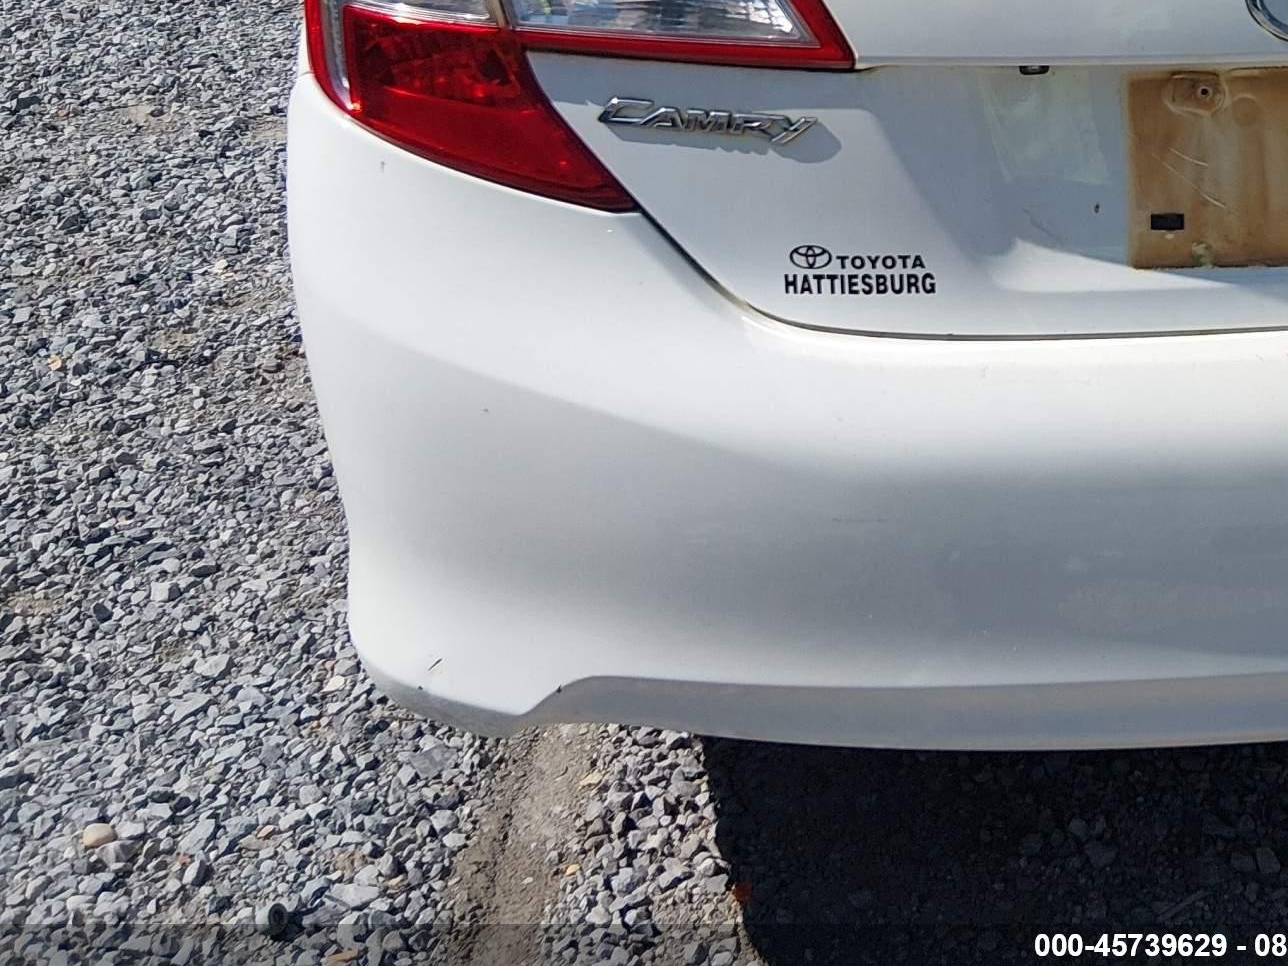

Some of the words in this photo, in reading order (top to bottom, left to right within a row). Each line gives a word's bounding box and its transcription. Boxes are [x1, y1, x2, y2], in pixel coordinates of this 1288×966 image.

[597, 95, 819, 145] CAMRY
[836, 254, 926, 270] TOYOTA
[784, 272, 937, 296] HATTIESBURG
